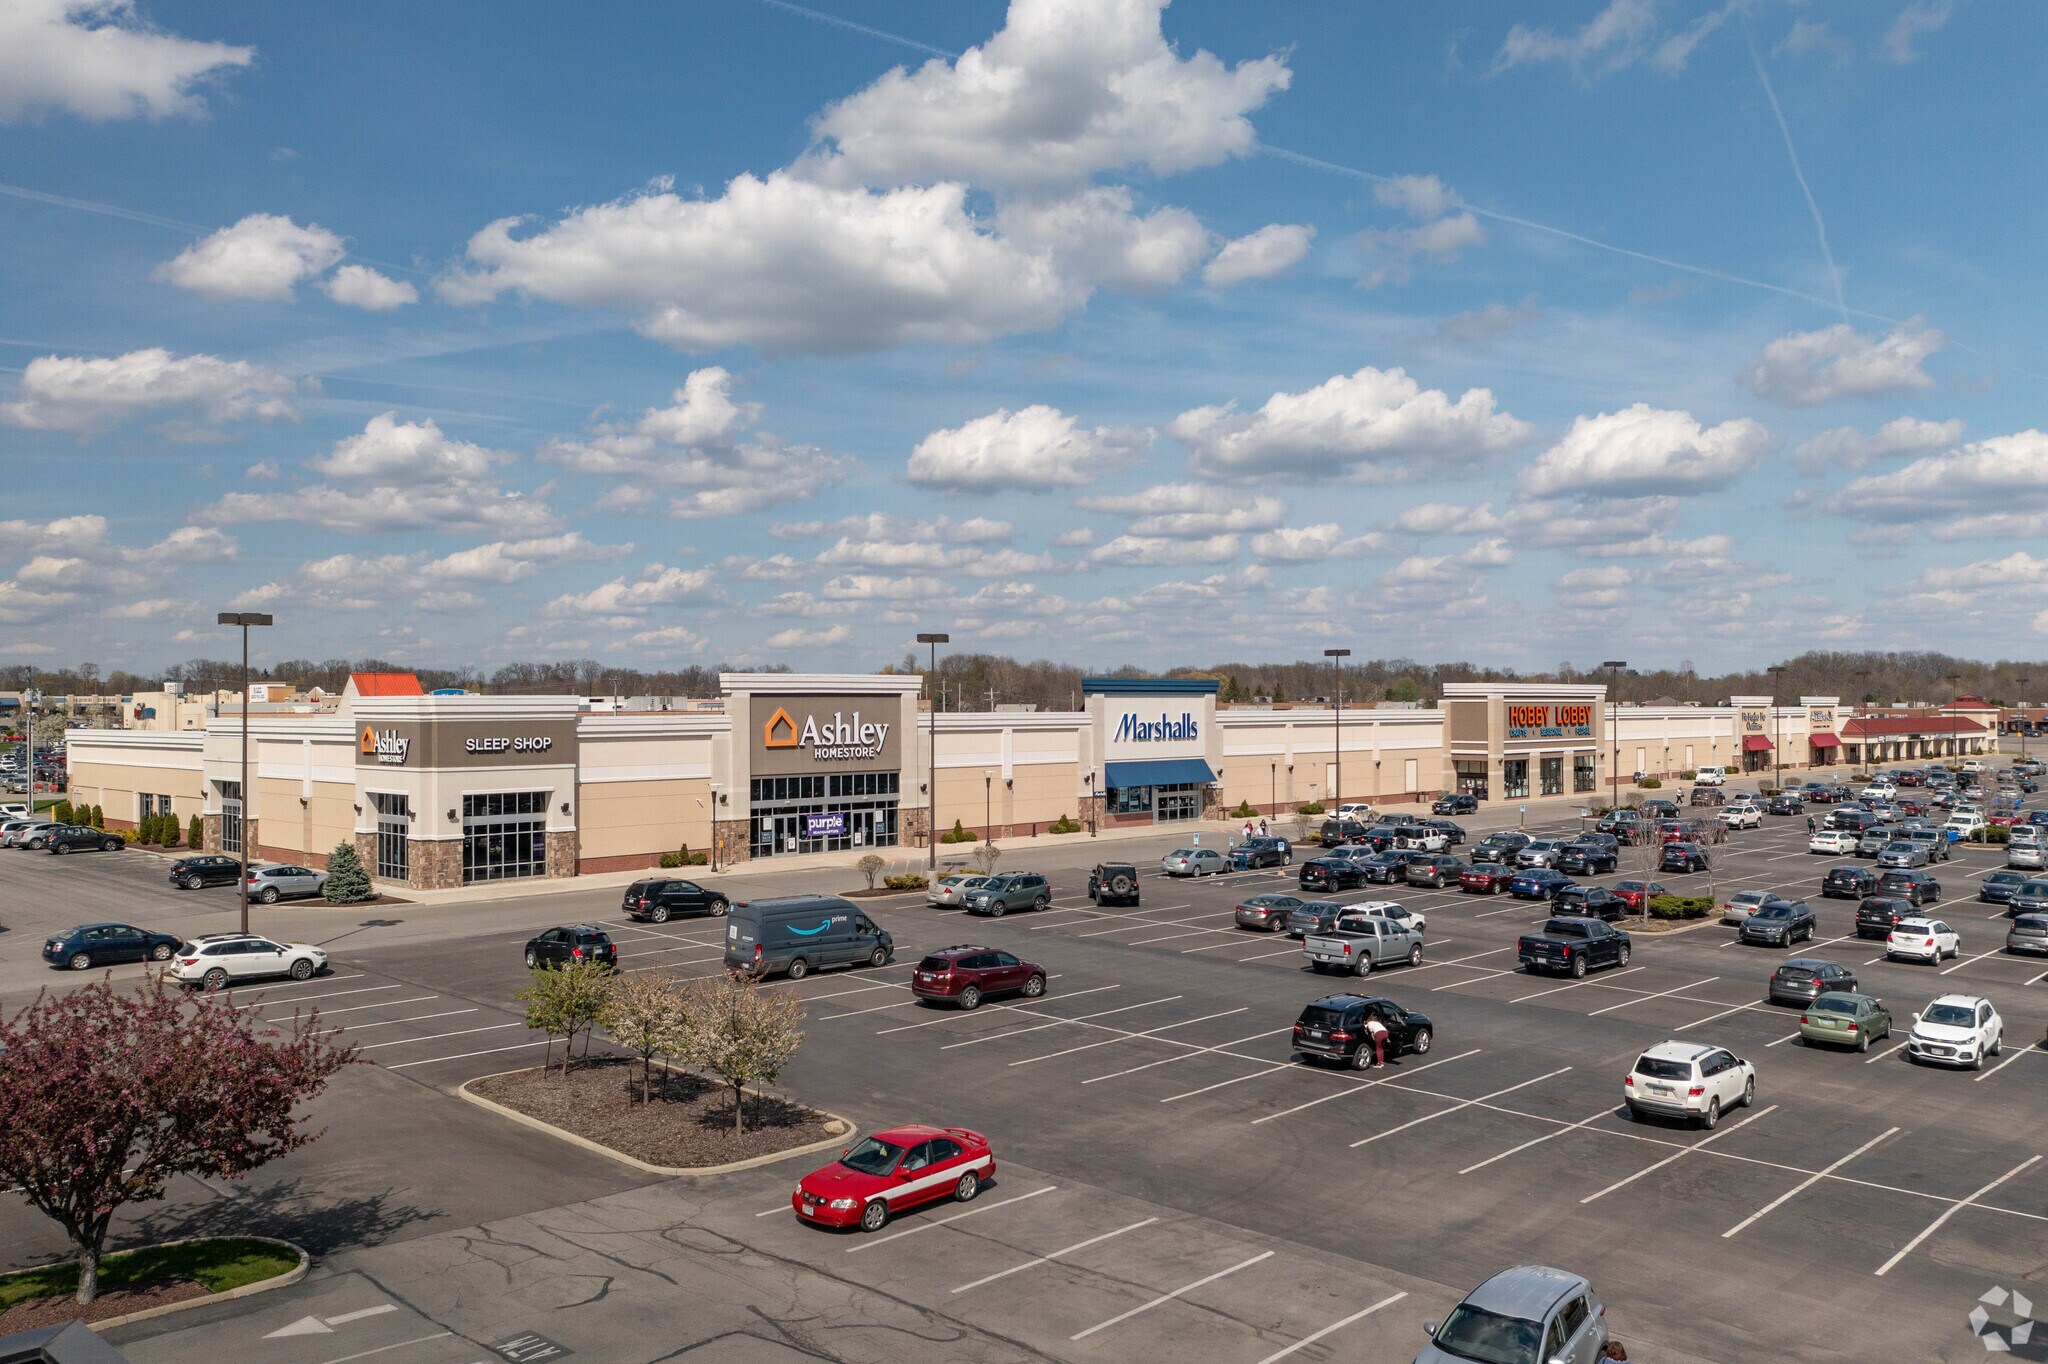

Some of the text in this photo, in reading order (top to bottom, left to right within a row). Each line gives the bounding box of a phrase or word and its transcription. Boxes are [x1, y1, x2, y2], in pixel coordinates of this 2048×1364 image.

[1509, 706, 1592, 725] HOBBY LOBBY
[799, 711, 889, 753] Ashley
[1113, 712, 1198, 741] Marshalls
[373, 729, 410, 759] Ashley
[466, 737, 552, 751] SLEEP SHOP
[378, 753, 404, 763] HOMESTORE
[814, 747, 875, 759] HOMESTORE
[808, 815, 842, 831] purple
[831, 915, 847, 924] prime
